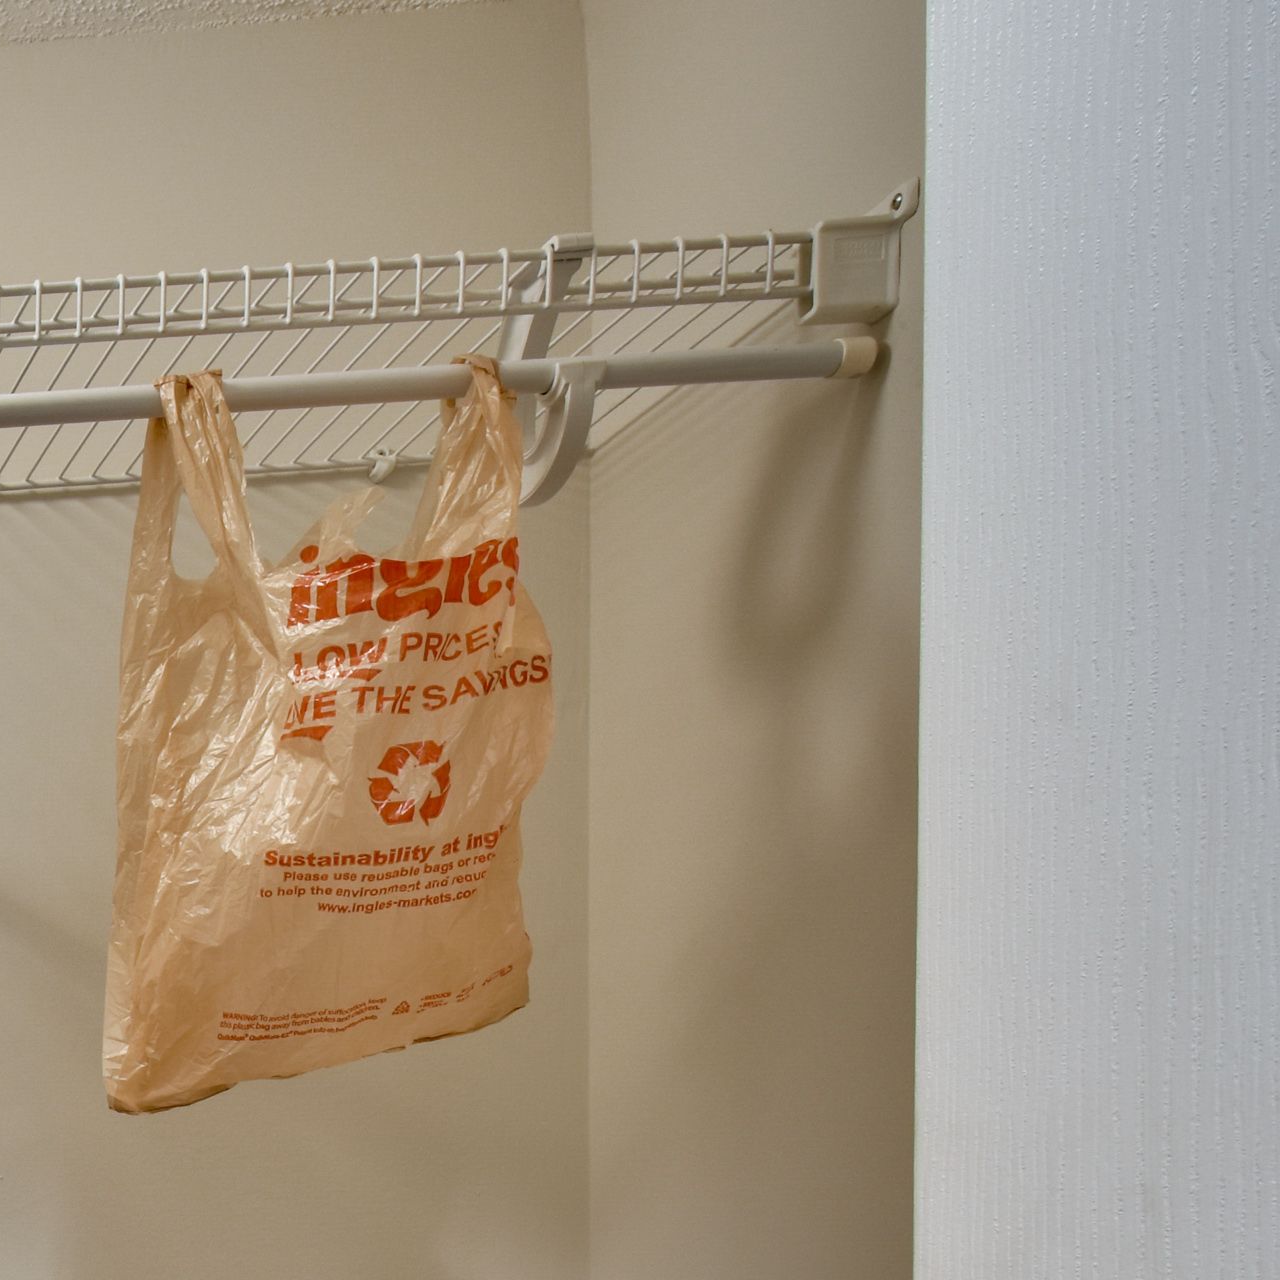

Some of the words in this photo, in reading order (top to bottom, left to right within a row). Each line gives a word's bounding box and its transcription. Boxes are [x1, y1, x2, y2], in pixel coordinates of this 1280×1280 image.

[352, 685, 416, 714] THE
[264, 845, 436, 868] Sustainability
[441, 837, 461, 858] at
[283, 871, 329, 883] Please
[333, 871, 358, 882] use
[361, 867, 420, 883] reusable
[423, 861, 454, 876] bags
[457, 857, 471, 867] or
[260, 887, 273, 899] to
[277, 886, 306, 899] help
[310, 885, 333, 896] the
[335, 881, 421, 899] environment
[424, 876, 449, 889] and
